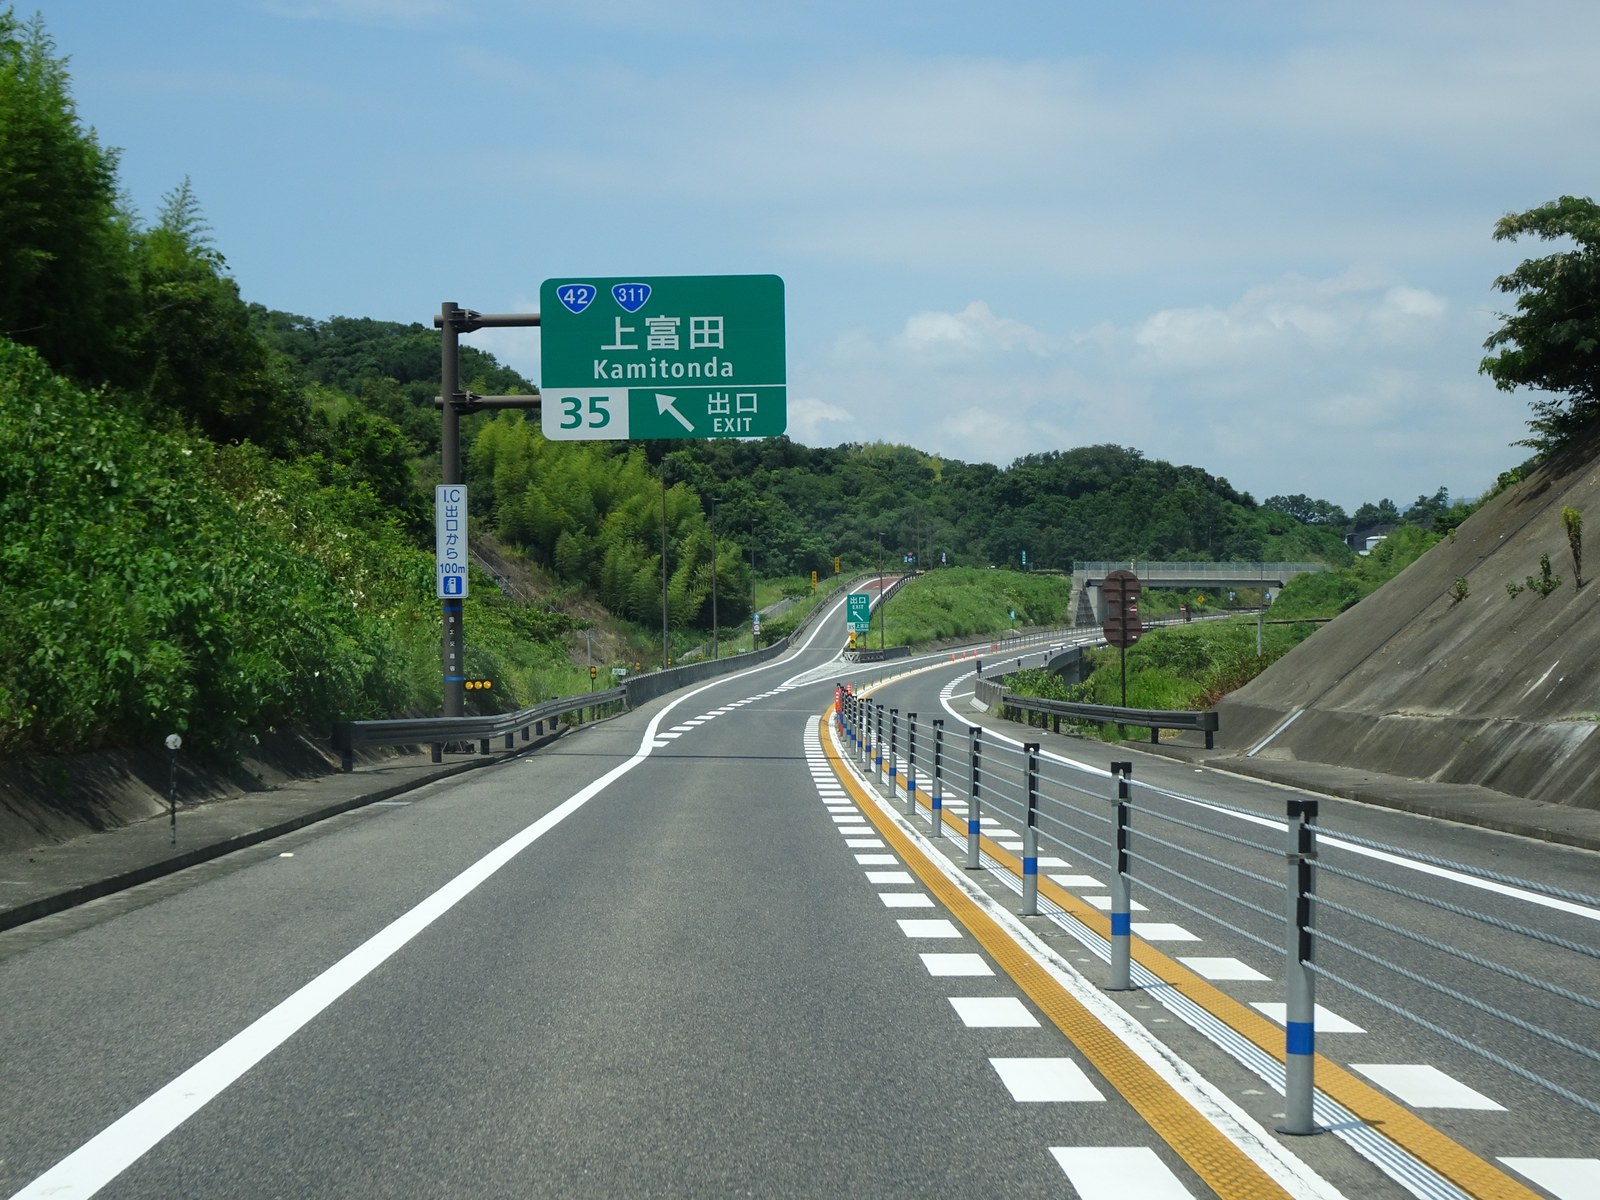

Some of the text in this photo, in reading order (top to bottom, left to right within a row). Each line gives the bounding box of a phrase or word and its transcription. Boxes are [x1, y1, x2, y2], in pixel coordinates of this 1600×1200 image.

[563, 288, 588, 305] 42
[618, 287, 645, 302] 311
[600, 315, 724, 351] 上富田
[594, 356, 734, 379] Kamitonda
[560, 396, 611, 430] 35
[707, 392, 758, 415] 出口
[713, 418, 752, 432] EXIT
[445, 505, 458, 560] 出口から
[440, 563, 466, 574] 100m
